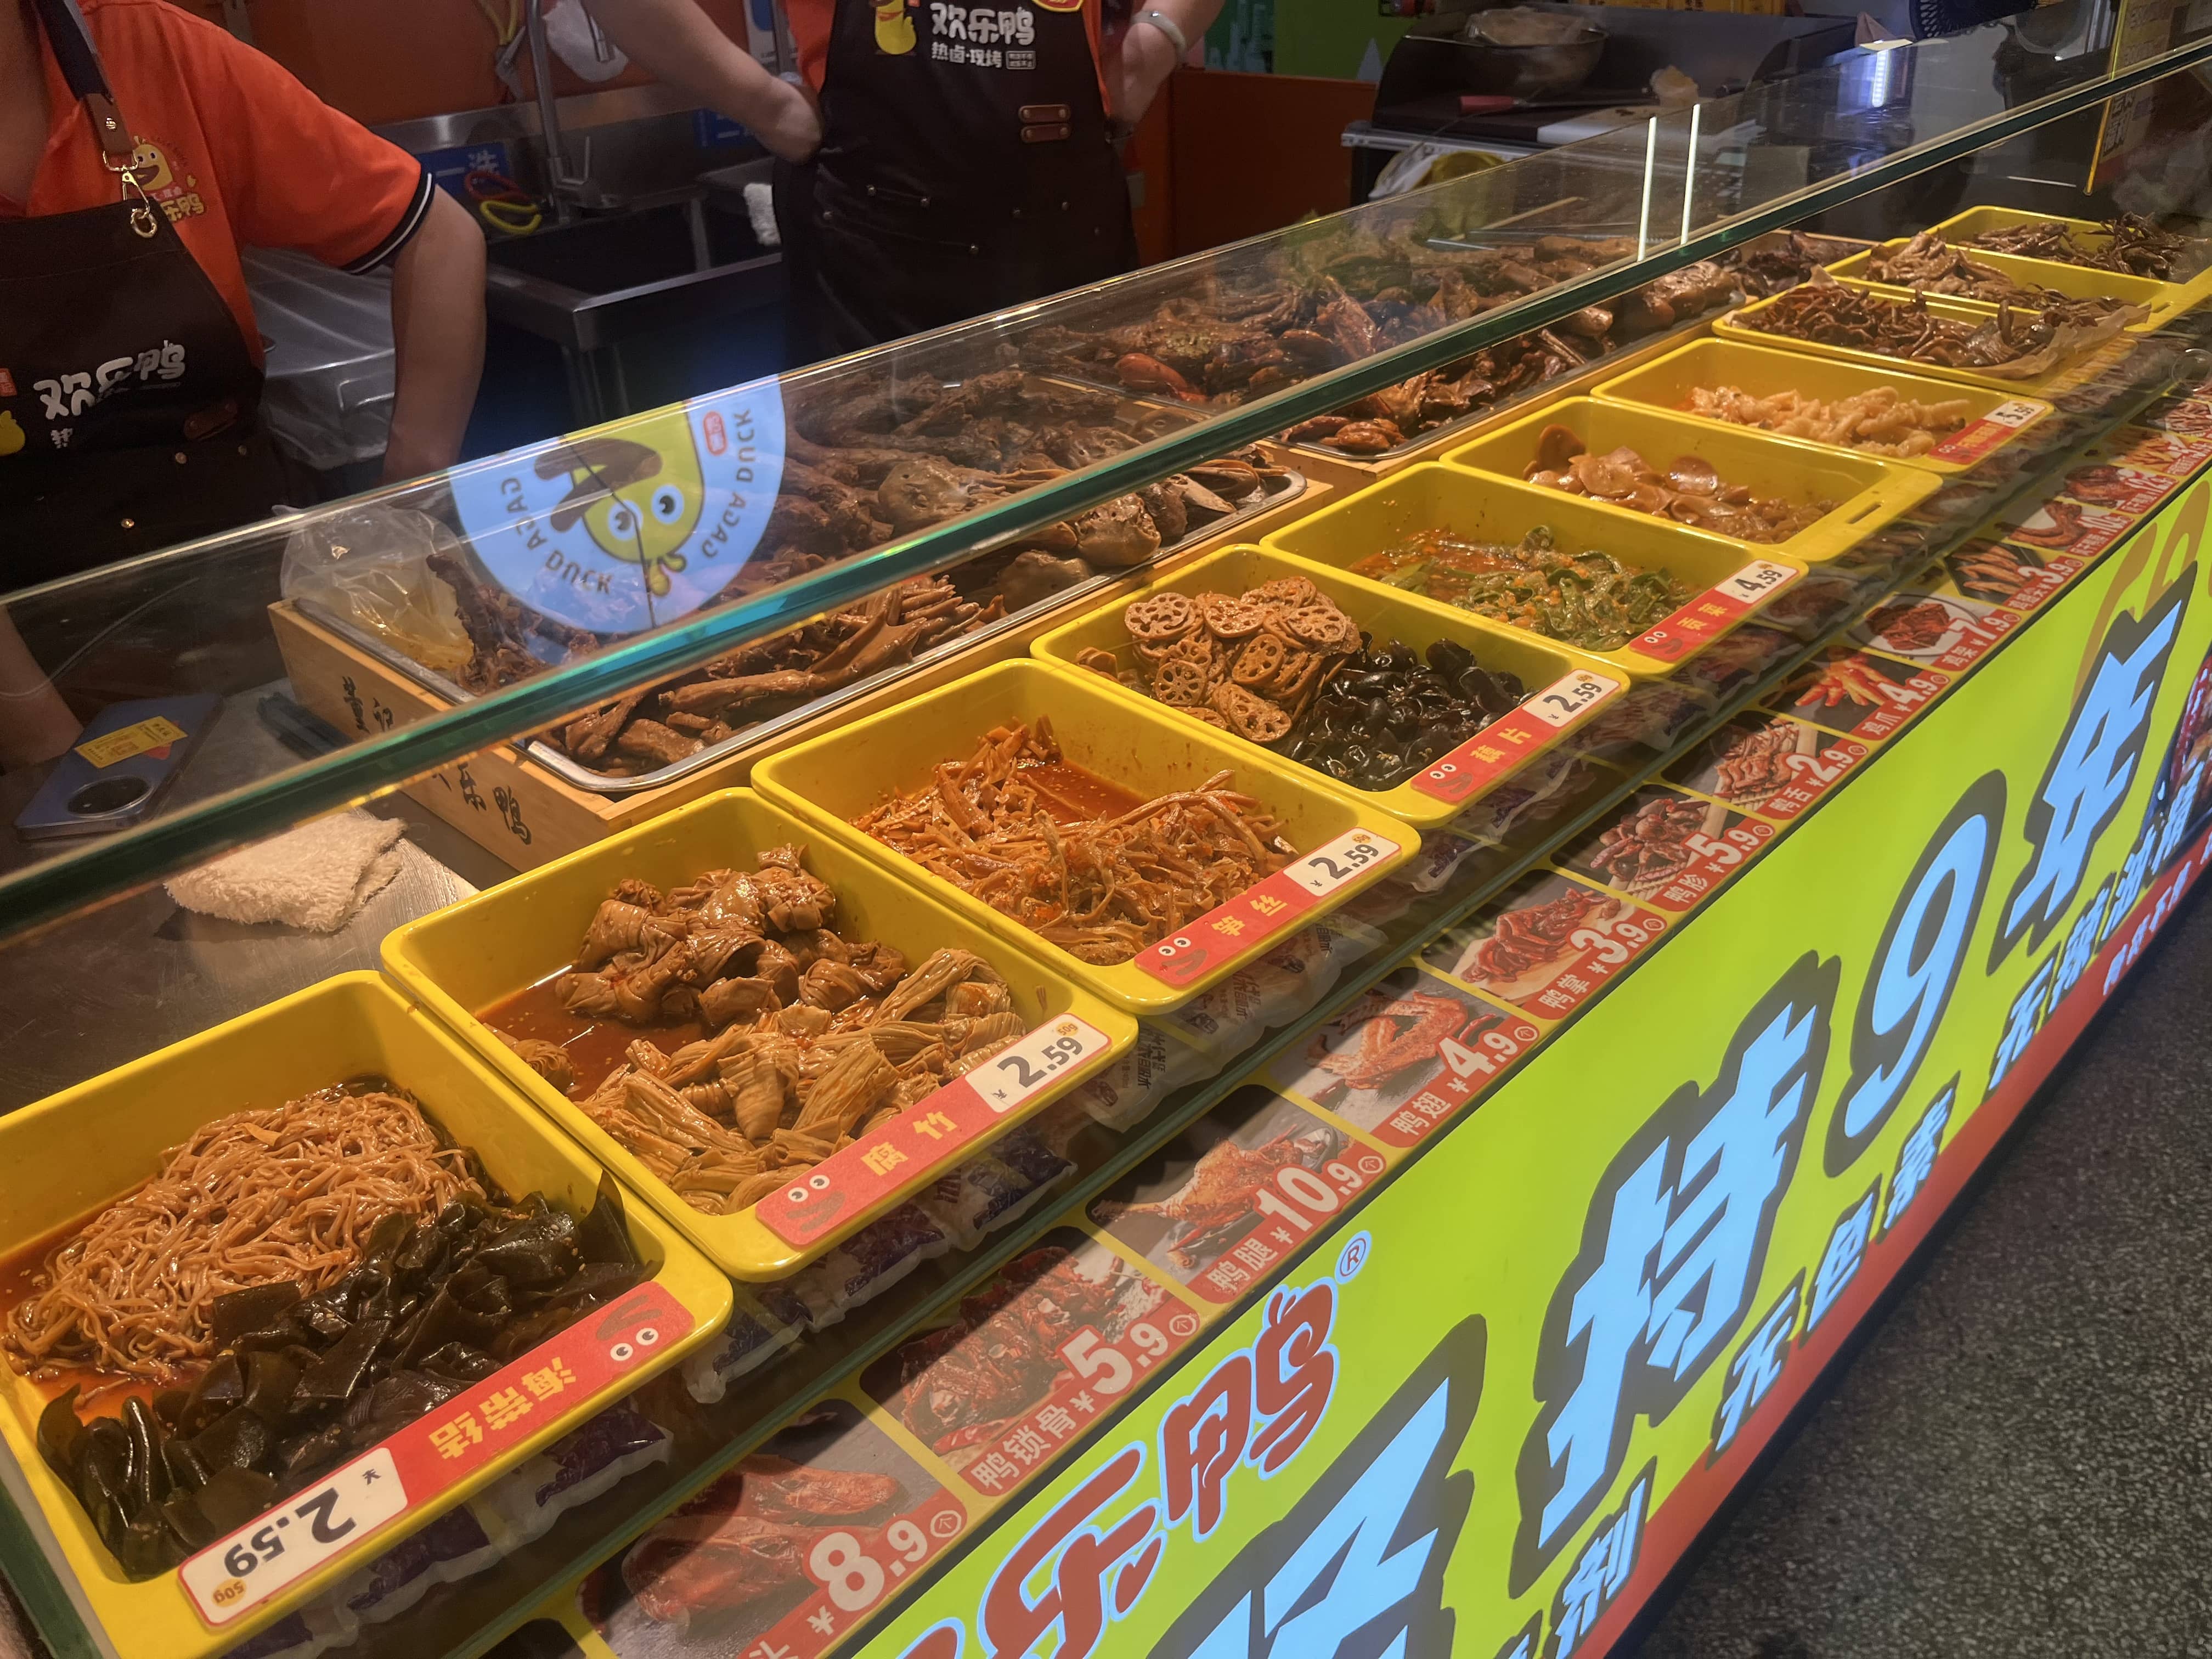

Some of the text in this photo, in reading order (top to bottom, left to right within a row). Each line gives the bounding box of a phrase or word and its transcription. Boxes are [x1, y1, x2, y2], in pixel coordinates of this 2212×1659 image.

[930, 2, 1035, 46] 欢乐鸭
[160, 193, 205, 221] 乐鸭
[1861, 710, 1902, 736] 鸡爪
[1470, 727, 1533, 764] 藕片
[1767, 787, 1813, 813] 鸭舌
[1662, 873, 1708, 904] 鸭胗
[1210, 895, 1289, 936] 笋丝
[1537, 974, 1590, 1011] 鸭掌
[860, 1110, 958, 1176] 腐竹
[1057, 1022, 1079, 1037] 50g
[1389, 1093, 1452, 1137] 鸭翅
[1207, 1237, 1279, 1291] 鸭腿
[1715, 1089, 1955, 1452] 无色素
[428, 1356, 576, 1462] 海带结
[970, 1403, 1077, 1491] 鸭锁骨
[895, 1281, 1336, 1659] 乐鸭
[211, 1581, 246, 1604] 50g
